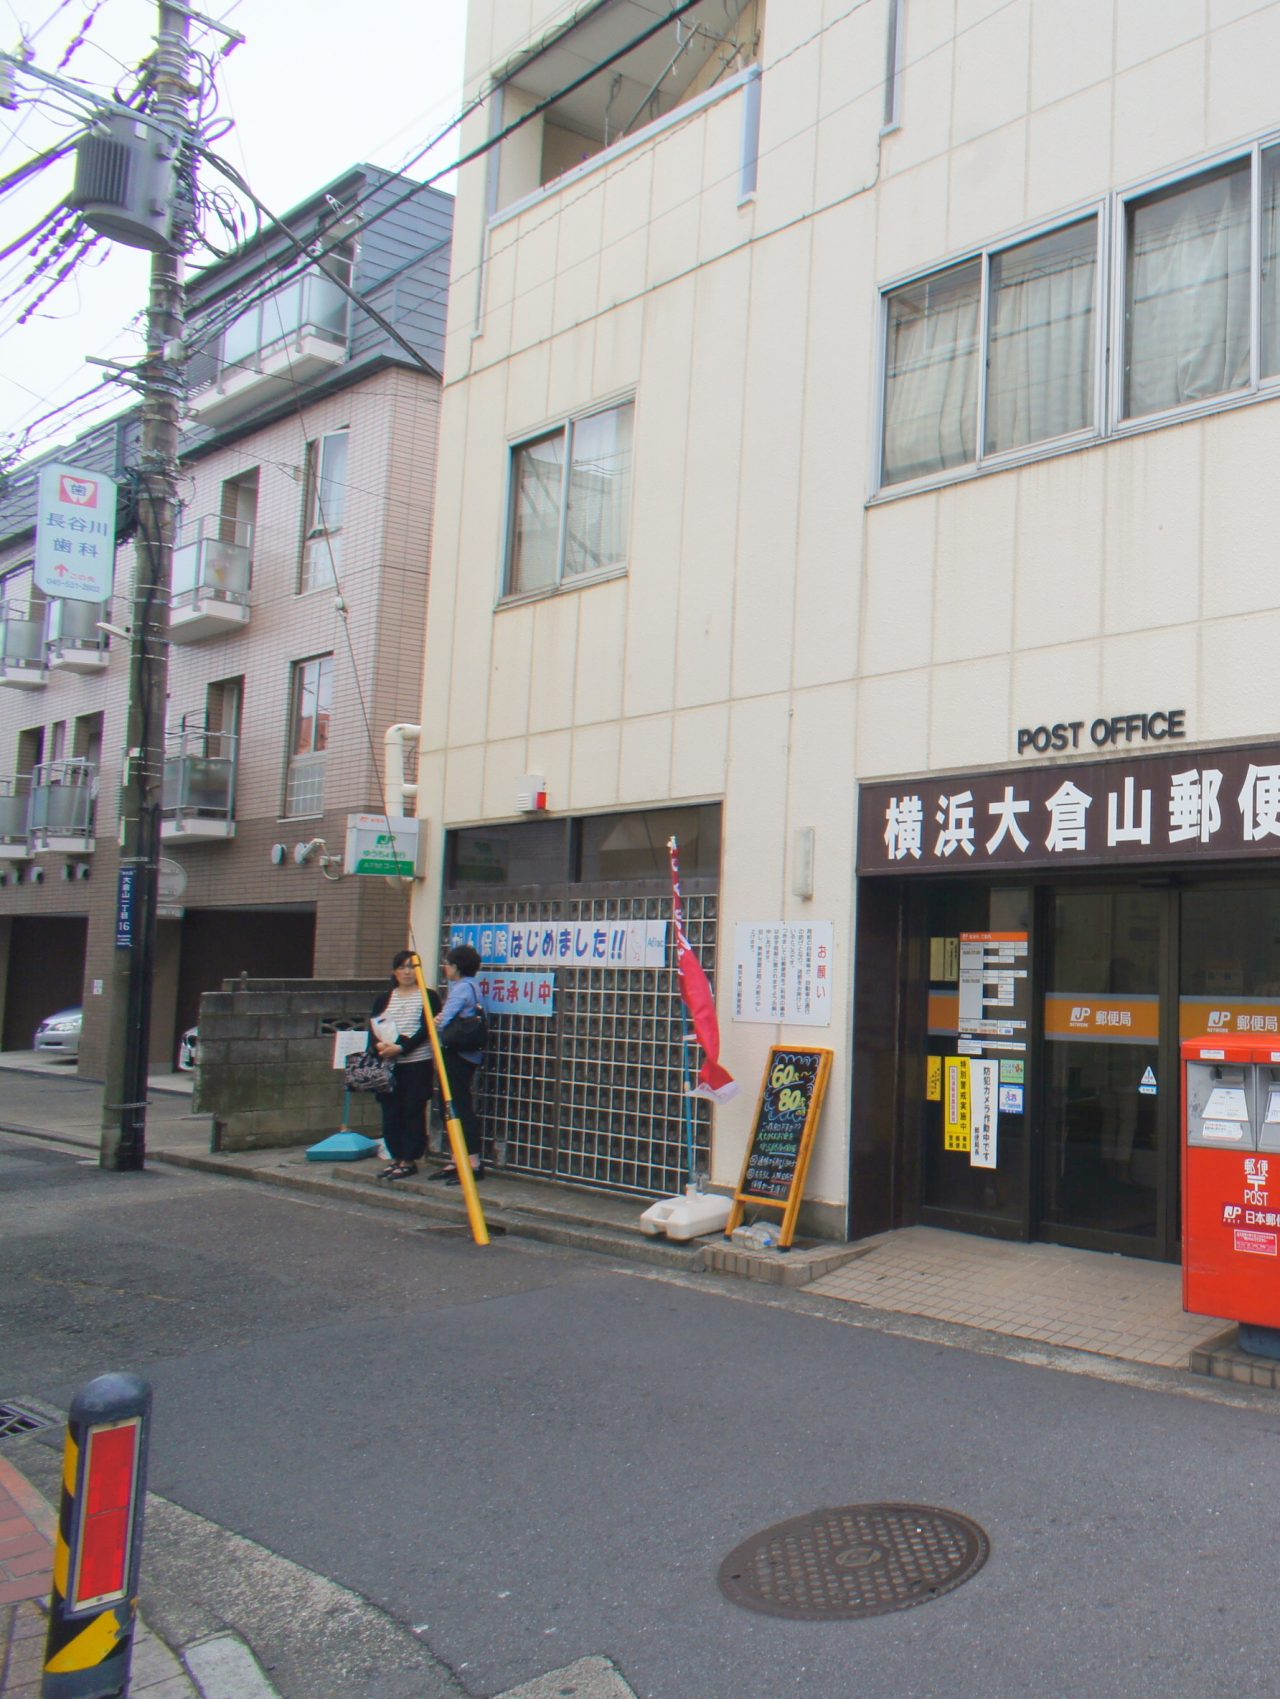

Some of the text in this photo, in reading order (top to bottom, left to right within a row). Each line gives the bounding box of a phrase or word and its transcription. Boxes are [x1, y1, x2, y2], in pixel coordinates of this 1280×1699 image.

[46, 512, 108, 537] 長谷川
[53, 538, 99, 559] 歯科
[1017, 710, 1186, 755] POST OFFICE
[816, 945, 828, 999] お願い
[1095, 1010, 1132, 1027] 郵便局
[1237, 1015, 1278, 1032] 郵便局
[1244, 1158, 1269, 1177] 郵便
[1244, 1189, 1269, 1206] POST
